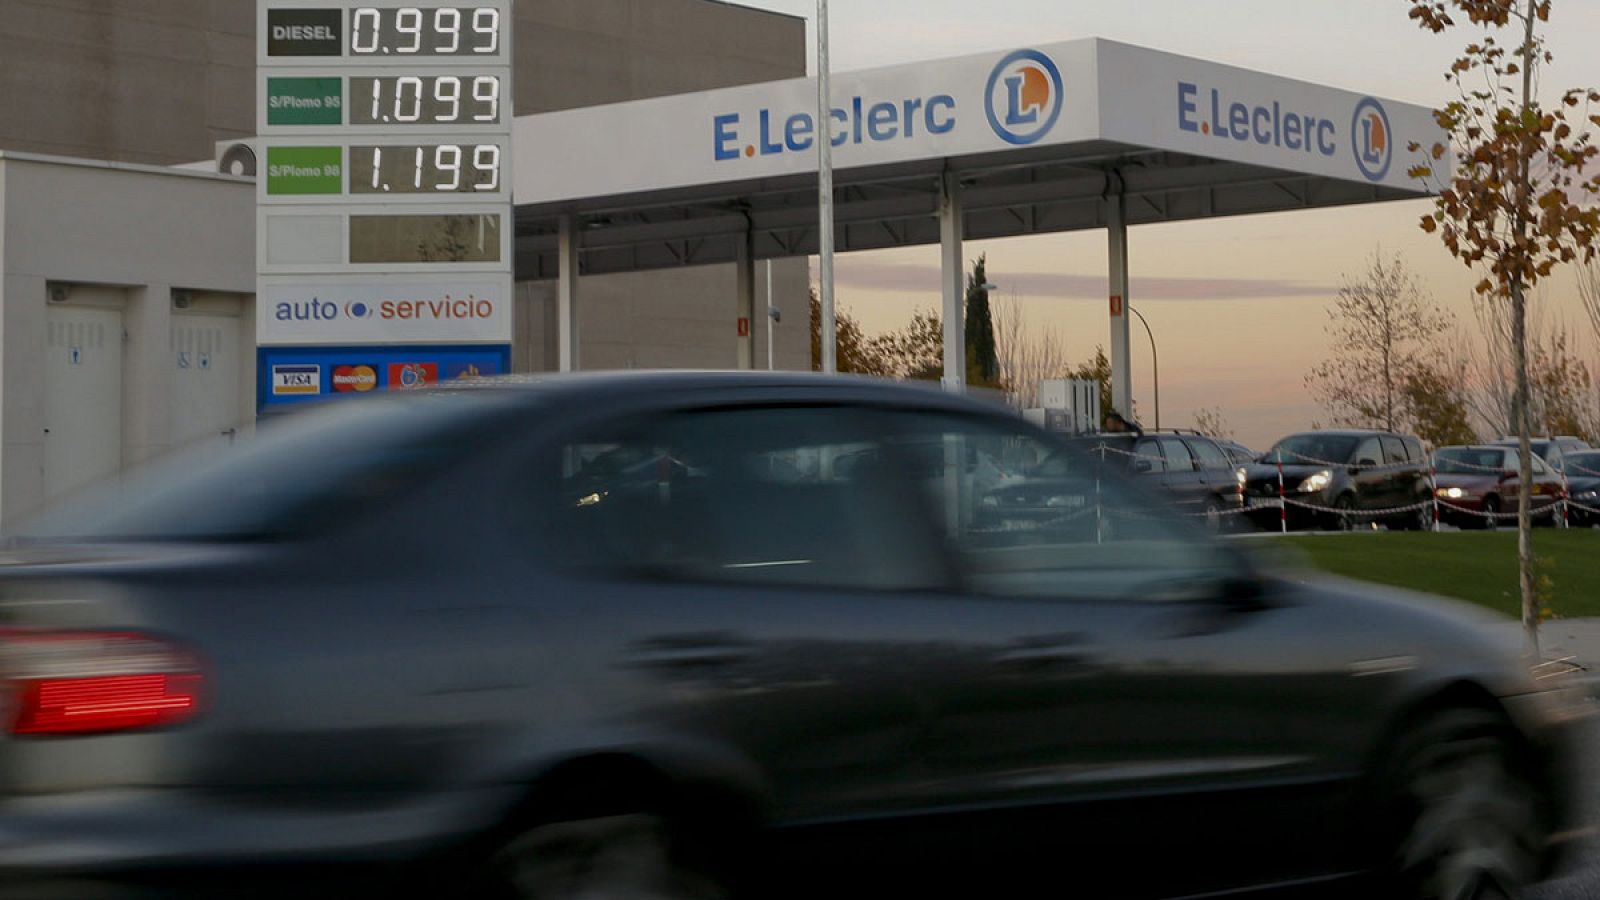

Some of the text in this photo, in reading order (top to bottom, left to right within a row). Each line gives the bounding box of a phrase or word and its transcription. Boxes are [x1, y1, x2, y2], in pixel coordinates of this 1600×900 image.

[273, 26, 336, 41] DIESEL
[352, 8, 499, 54] 0.999
[270, 95, 341, 109] S/Plomo 95
[372, 76, 499, 122] 1.099
[714, 95, 956, 161] E.Leclerc
[1178, 81, 1336, 156] E.Leclerc
[269, 164, 321, 178] S/Plomo
[372, 145, 500, 191] 1.199
[276, 294, 493, 321] auto servicio
[283, 375, 312, 386] VISA
